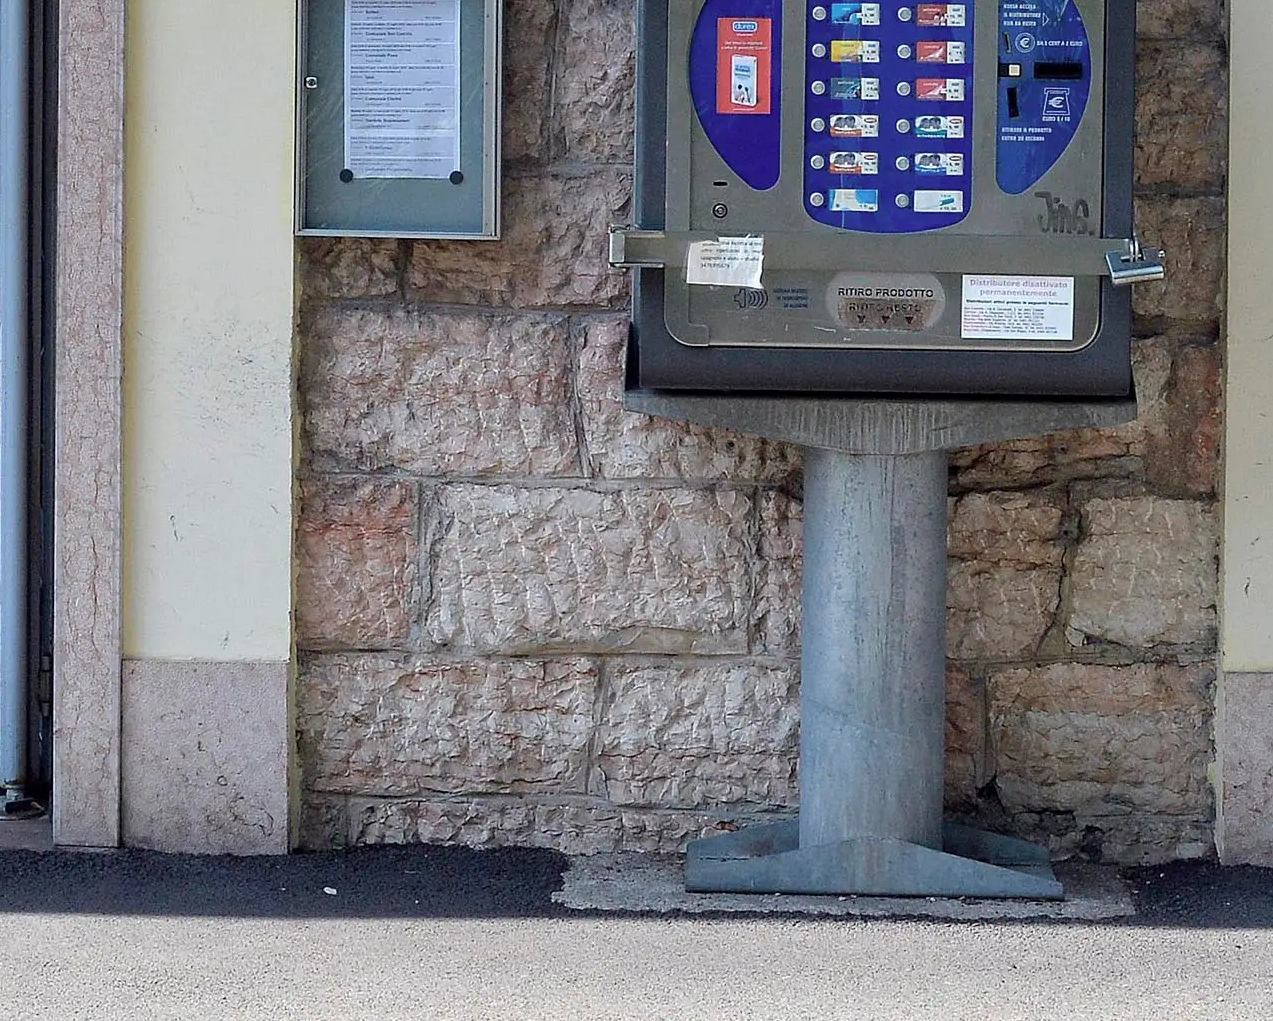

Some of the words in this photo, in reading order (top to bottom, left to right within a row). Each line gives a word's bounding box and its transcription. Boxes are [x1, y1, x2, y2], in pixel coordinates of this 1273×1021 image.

[970, 279, 1021, 287] Distributore
[1022, 280, 1068, 288] disattivato
[838, 287, 873, 297] RITIRO
[875, 288, 934, 298] PRODOTTO
[980, 289, 1057, 297] permanentemente
